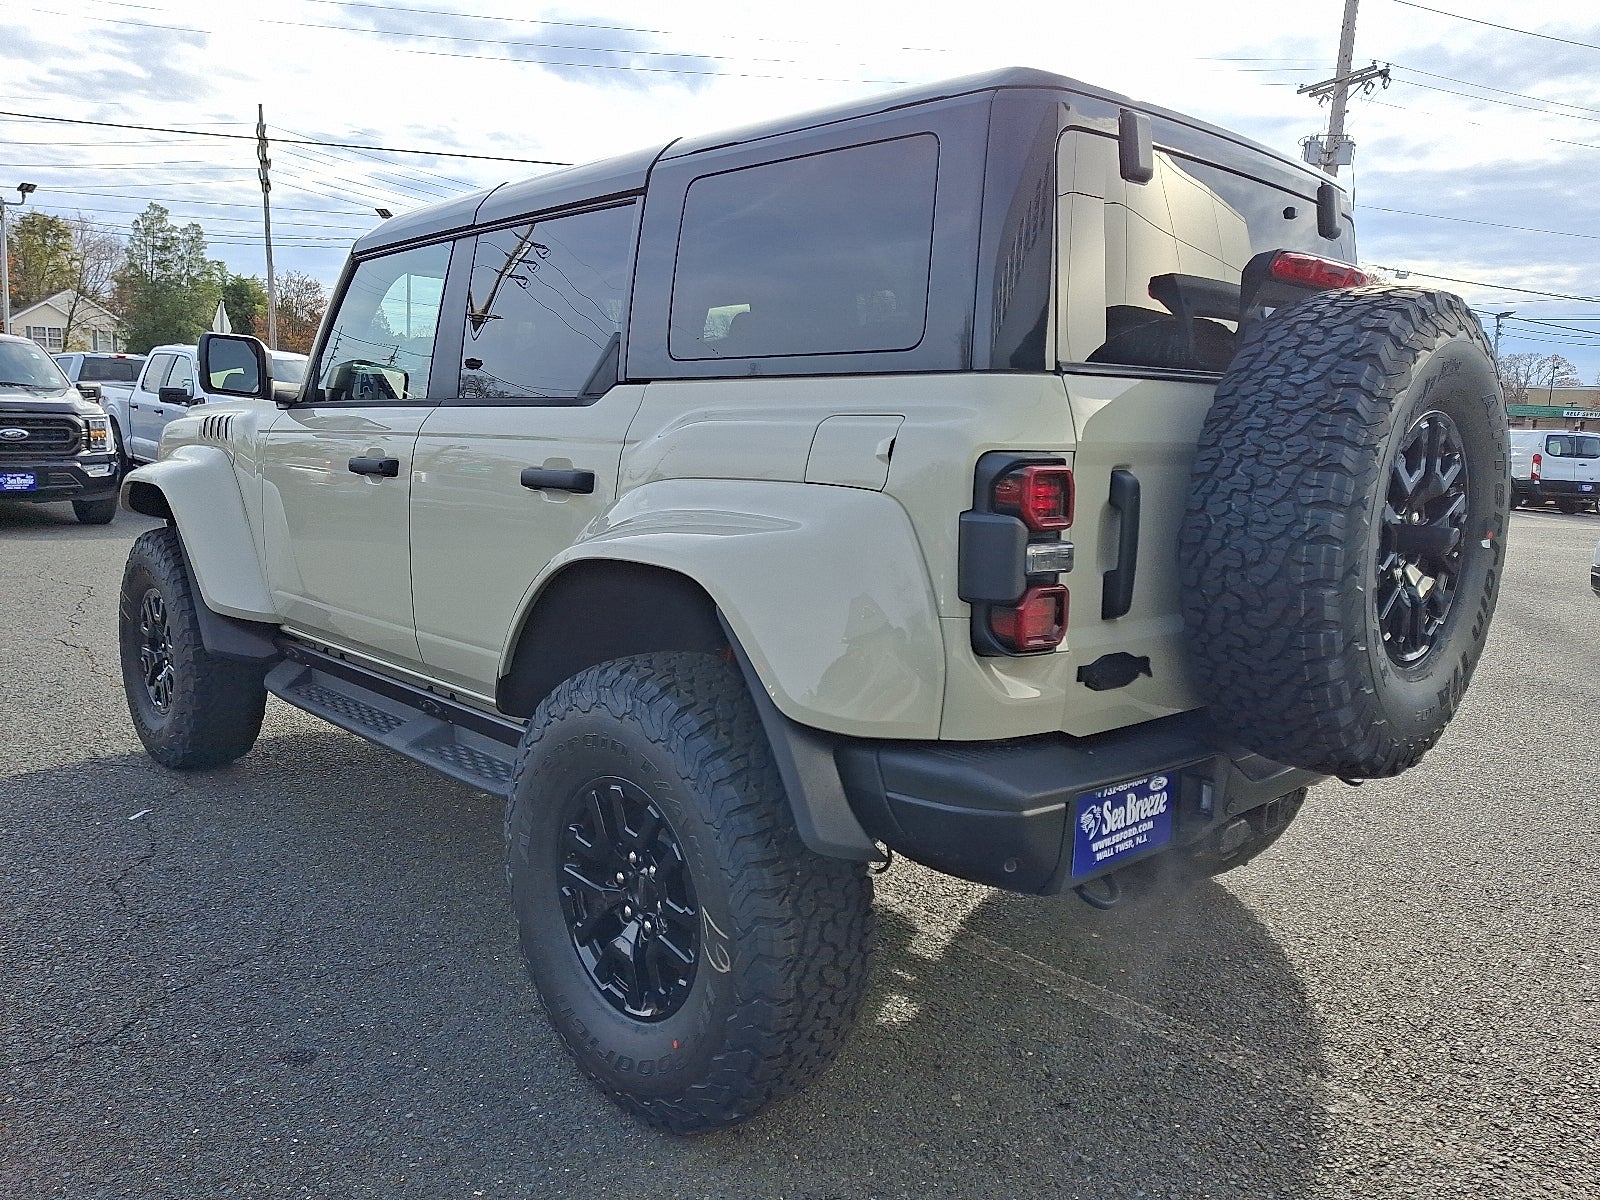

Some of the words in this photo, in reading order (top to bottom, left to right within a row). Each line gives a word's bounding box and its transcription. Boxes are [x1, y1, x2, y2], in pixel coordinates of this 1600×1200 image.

[1102, 800, 1126, 836] Sea
[1126, 791, 1168, 826] Breeze
[1096, 847, 1114, 861] WALL
